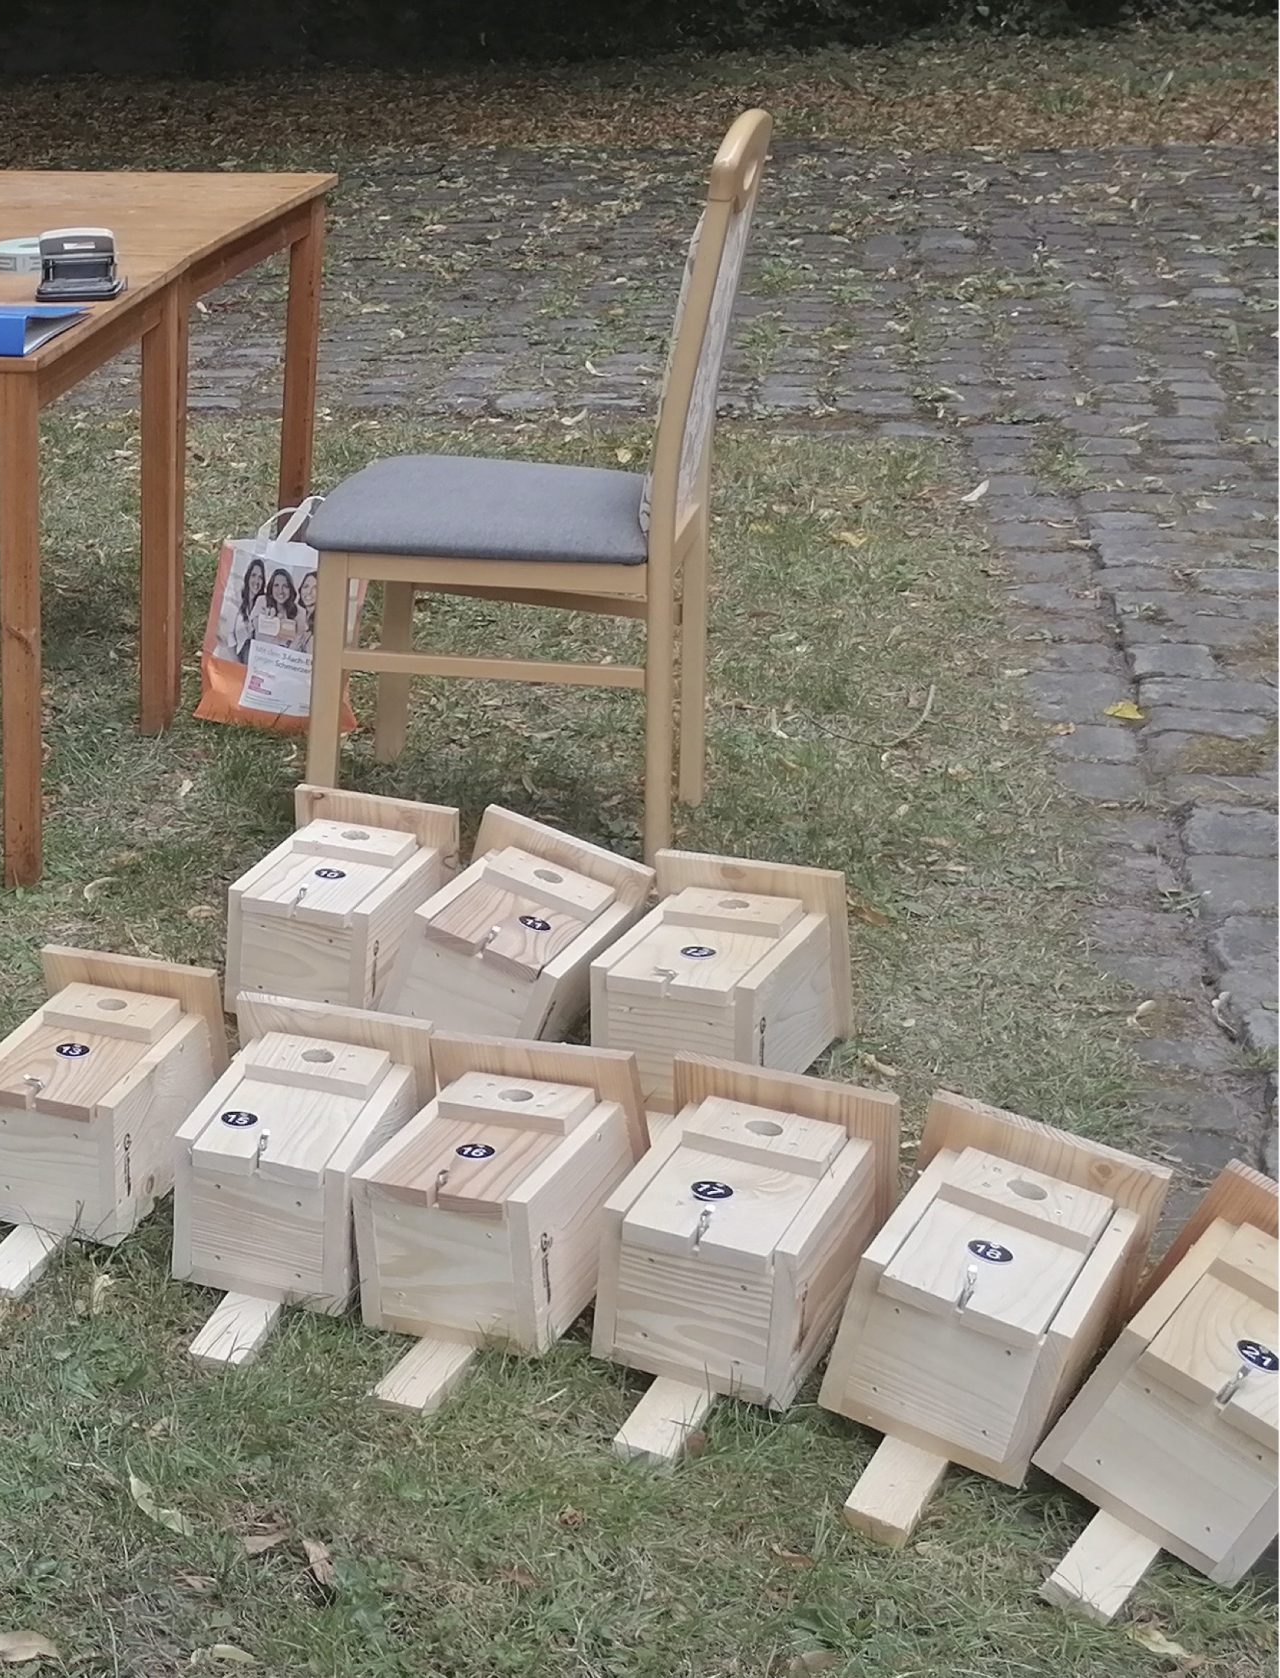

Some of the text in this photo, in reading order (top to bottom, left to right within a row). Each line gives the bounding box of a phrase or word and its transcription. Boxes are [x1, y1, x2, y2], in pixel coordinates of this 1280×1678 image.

[63, 1046, 82, 1055] 13
[228, 1114, 248, 1124] 15
[463, 1146, 486, 1156] 16
[698, 1183, 725, 1195] 17
[976, 1244, 1002, 1259] 18
[1242, 1345, 1271, 1367] 21
